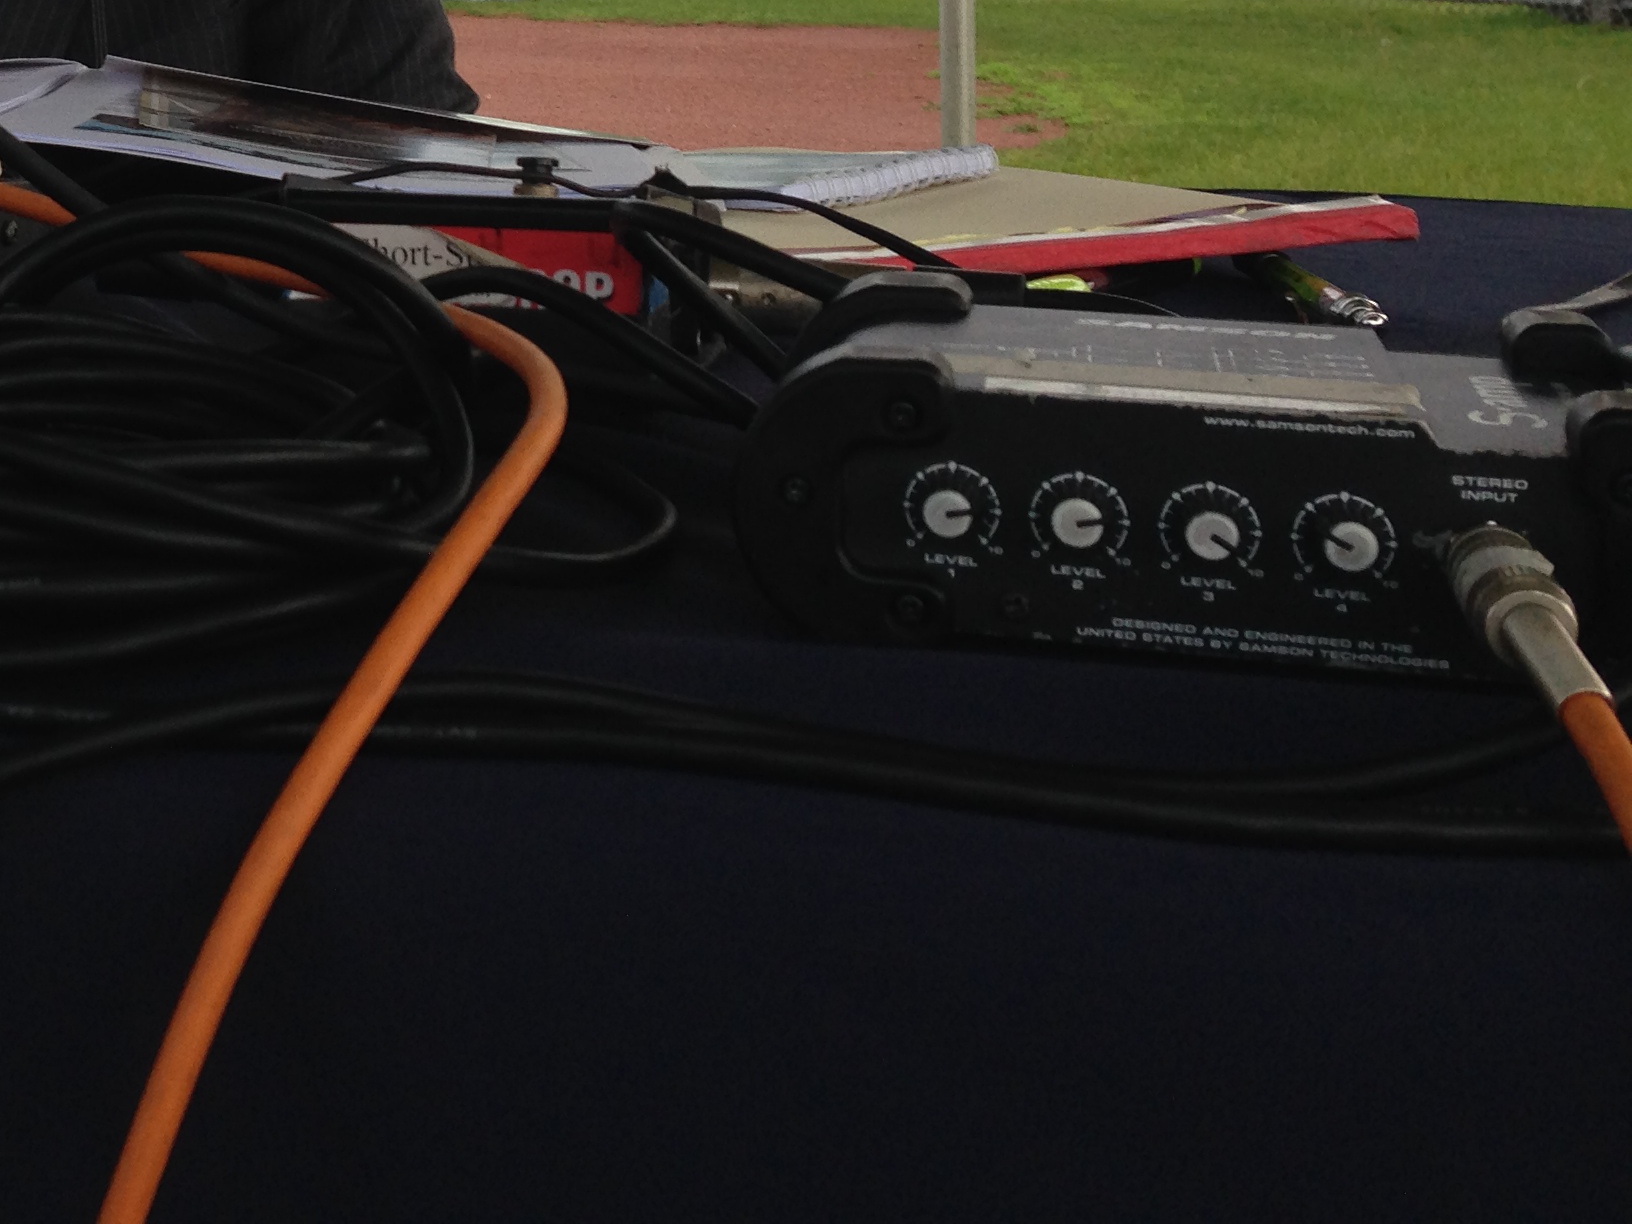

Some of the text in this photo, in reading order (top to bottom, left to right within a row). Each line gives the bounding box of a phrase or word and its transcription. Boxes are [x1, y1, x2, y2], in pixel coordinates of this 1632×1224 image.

[1203, 415, 1416, 439] www.samsontech.com
[1451, 475, 1529, 491] STEREO
[1460, 489, 1519, 505] INPUT
[924, 552, 978, 567] LEVEL
[946, 568, 956, 577] 1
[1050, 564, 1106, 579] LEVEL
[1071, 579, 1085, 590] 2
[1180, 576, 1237, 590] LEVEL
[1202, 590, 1216, 602] 3
[1313, 587, 1370, 602] LEVEL
[1335, 603, 1347, 613] 4
[1111, 617, 1413, 654] DESIGNED AND ENGINEERED IN THE
[1076, 626, 1451, 670] UNITED STATES BY SAMSON TECHNOLOGIES
